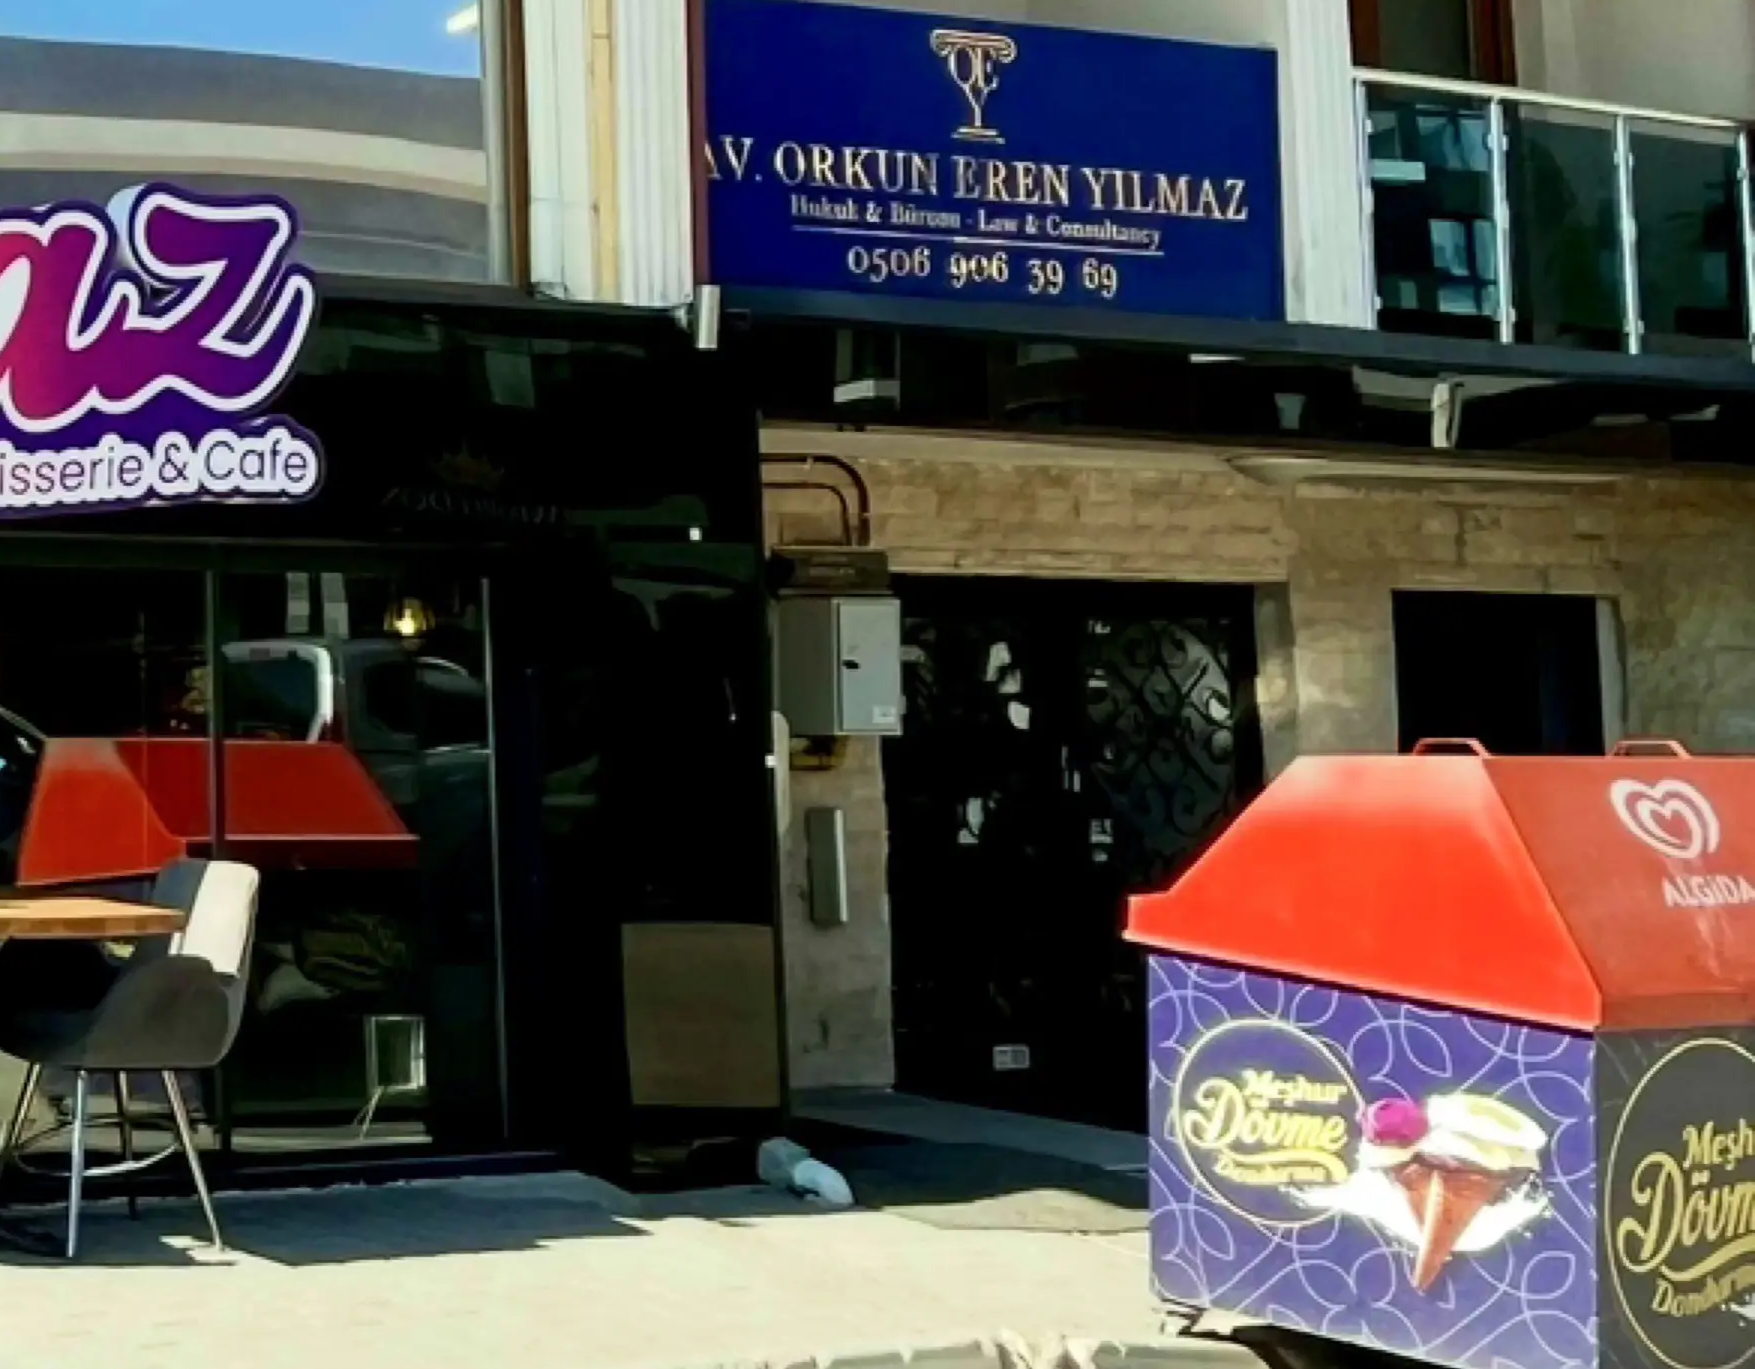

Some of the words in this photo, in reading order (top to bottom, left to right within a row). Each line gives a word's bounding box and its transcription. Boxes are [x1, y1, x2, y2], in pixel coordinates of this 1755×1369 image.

[774, 140, 940, 197] ORKUN
[951, 154, 1071, 208] EREN
[1083, 166, 1249, 221] YILMAZ
[790, 193, 859, 222] Hukuk
[866, 199, 885, 224] &
[977, 208, 1019, 234] Law
[848, 244, 932, 283] 0506
[949, 251, 1010, 289] 906
[1027, 257, 1064, 297] 39
[1082, 256, 1119, 300] 69
[157, 443, 190, 487] &
[202, 434, 309, 487] Cafe
